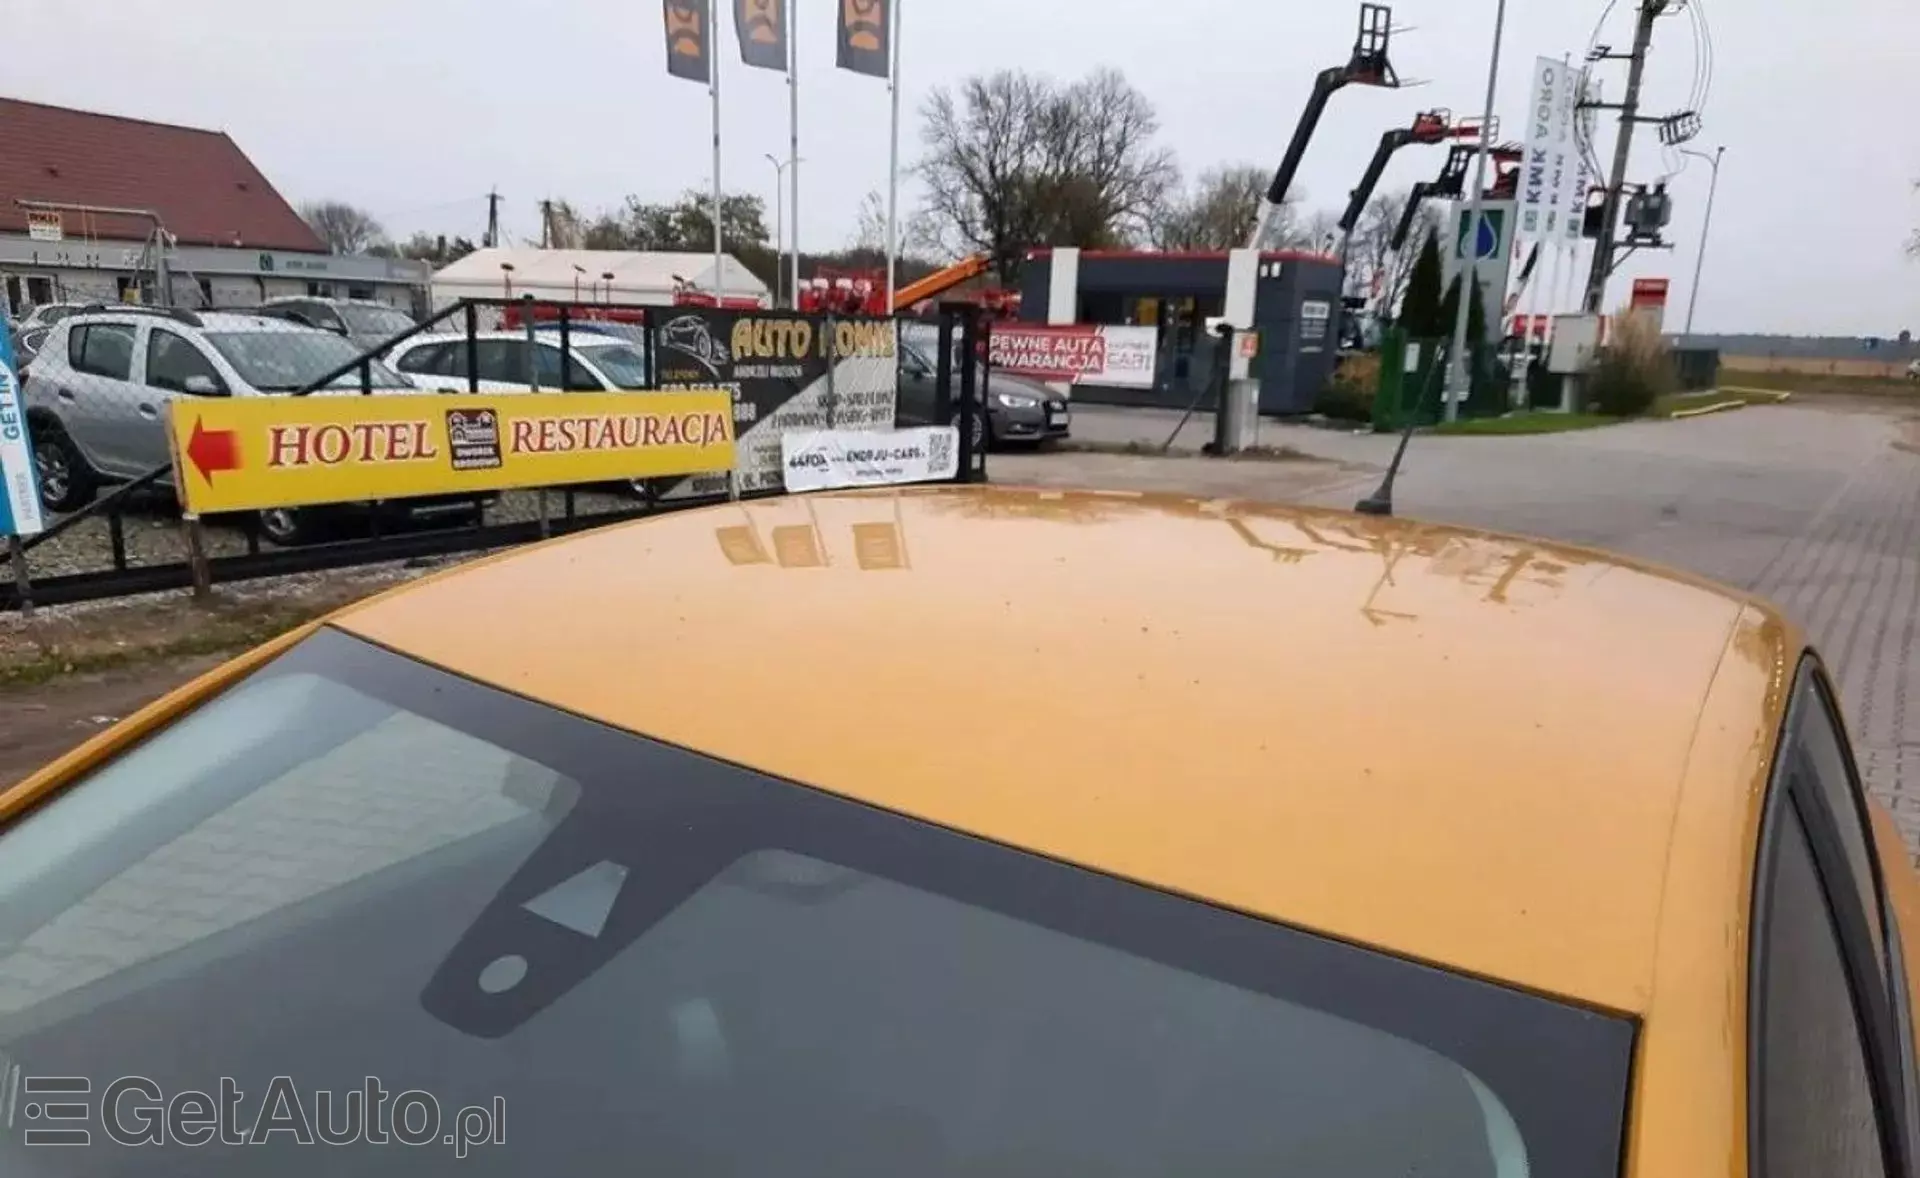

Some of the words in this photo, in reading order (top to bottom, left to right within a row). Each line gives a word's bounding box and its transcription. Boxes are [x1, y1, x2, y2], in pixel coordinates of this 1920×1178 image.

[731, 318, 811, 361] AUTO
[989, 335, 1050, 351] PEWNE
[1054, 337, 1102, 353] AUTA
[989, 352, 1100, 370] GWARANCJA
[269, 422, 437, 467] HOTEL
[511, 413, 728, 453] RESTAURACJA
